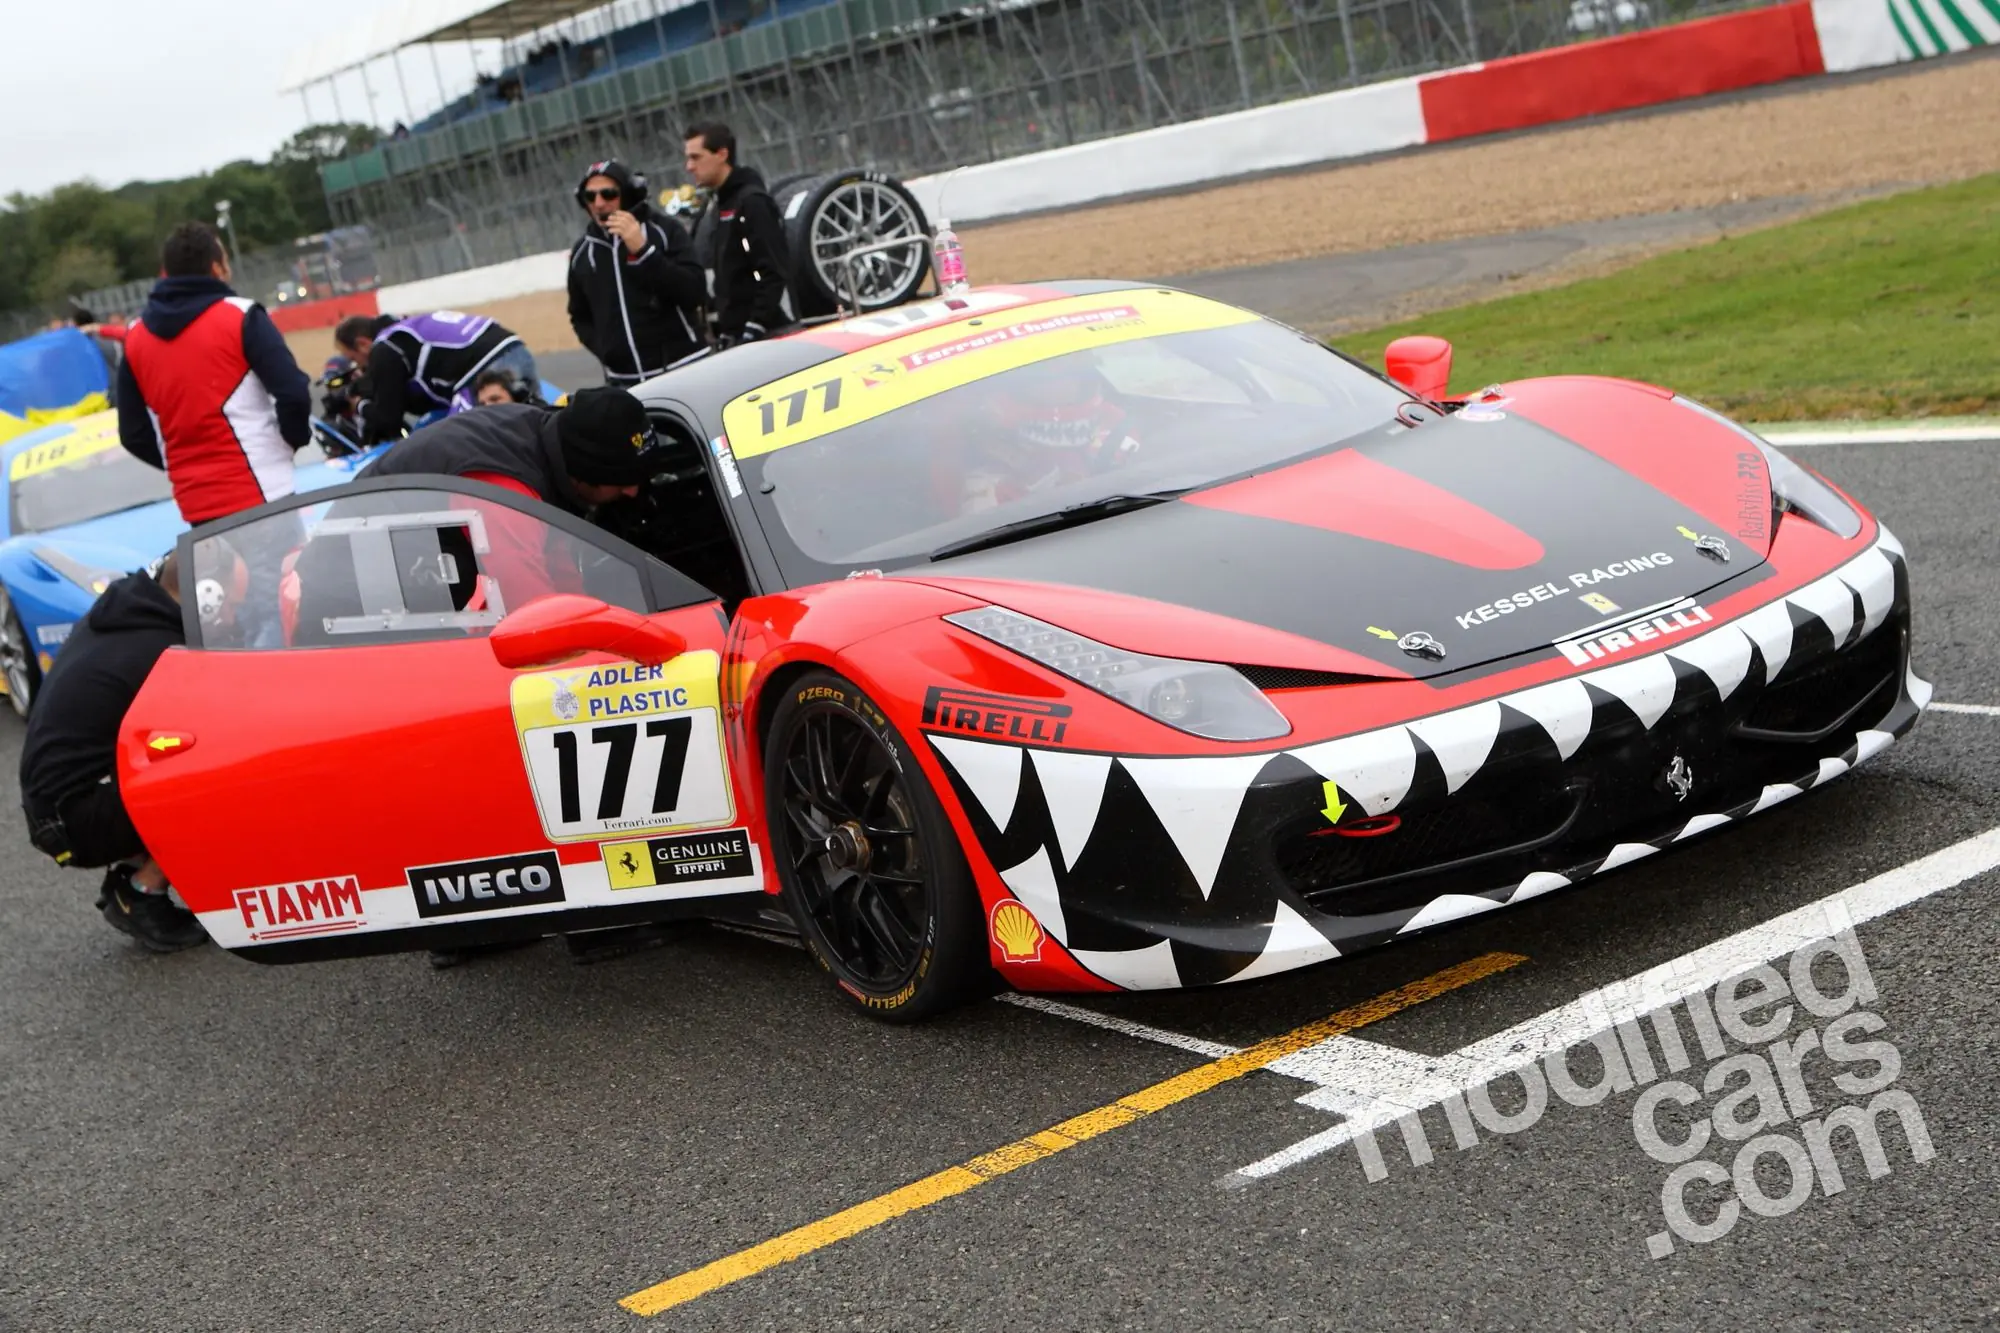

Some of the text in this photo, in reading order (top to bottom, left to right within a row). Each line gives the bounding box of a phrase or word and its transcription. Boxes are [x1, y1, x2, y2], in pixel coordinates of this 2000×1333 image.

[910, 308, 1129, 367] Ferrari Challenge
[758, 377, 842, 436] 177
[1455, 551, 1675, 630] KESSEL RACING
[1551, 596, 1713, 667] PIRELLI
[587, 664, 663, 688] ADLER
[589, 687, 688, 717] PLASTIC
[920, 685, 1073, 744] PIRELLI
[553, 715, 692, 824] 177
[603, 815, 673, 831] Ferrari.com
[656, 839, 744, 861] GENUINE
[674, 859, 726, 876] Ferrari
[236, 878, 364, 929] FIAMM
[423, 865, 551, 905] IVECO
[868, 980, 917, 1010] PIRELLI
